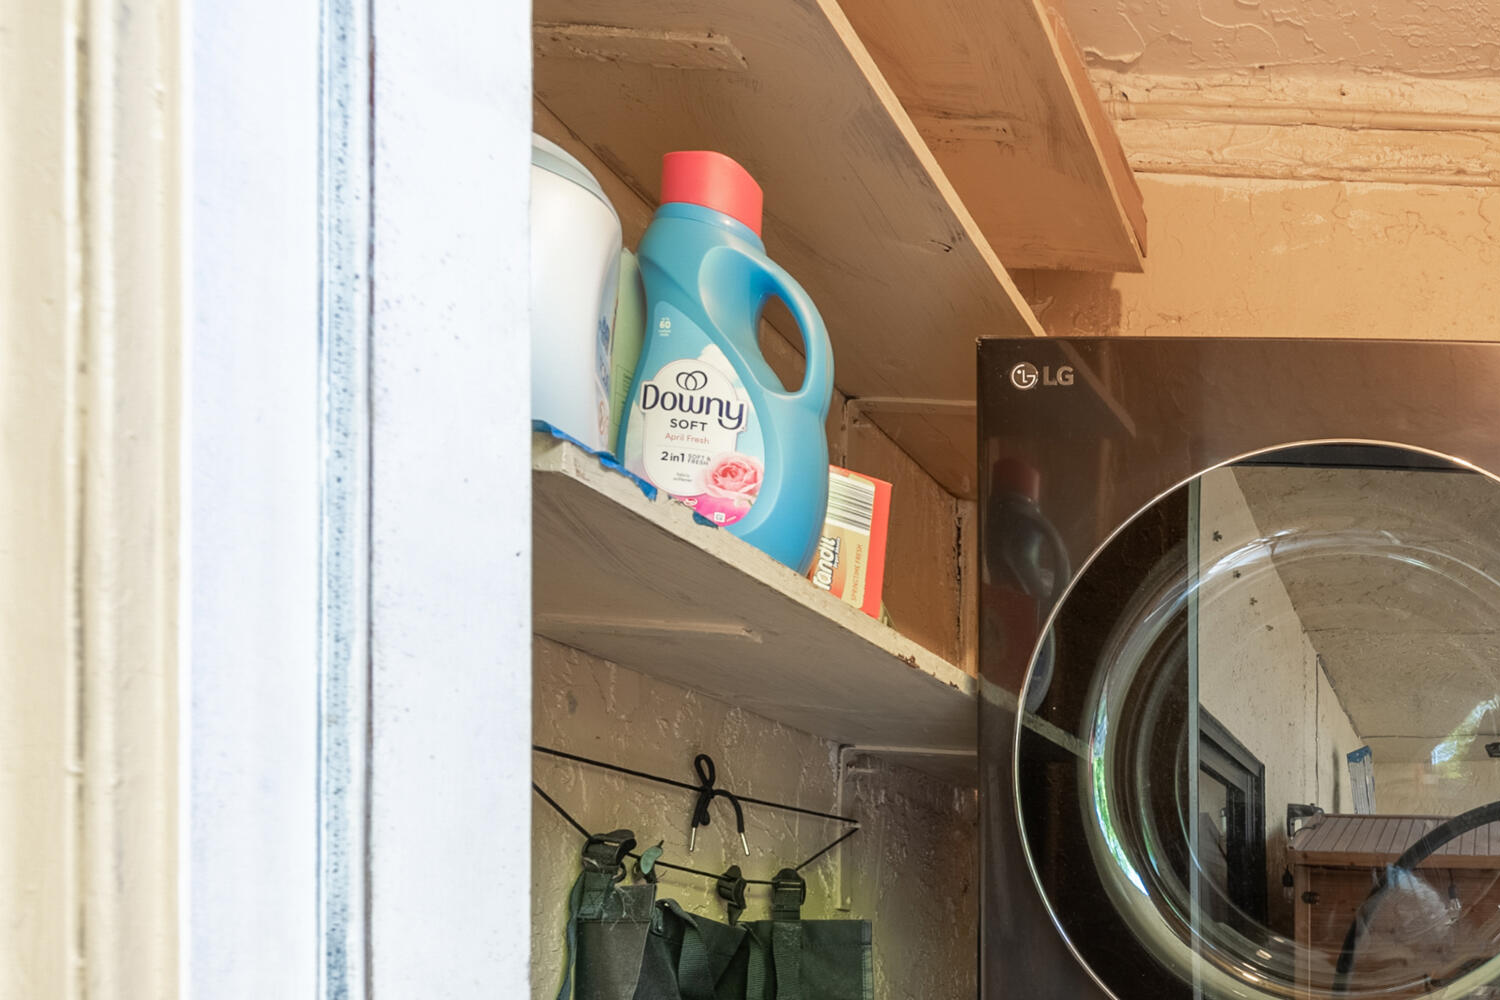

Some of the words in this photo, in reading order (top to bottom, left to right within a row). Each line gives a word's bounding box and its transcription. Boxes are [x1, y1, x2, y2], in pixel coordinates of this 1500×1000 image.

[1043, 366, 1074, 386] LG
[642, 384, 744, 430] Downy
[670, 418, 708, 431] SOFT
[665, 432, 685, 442] April
[686, 434, 709, 444] Fresh
